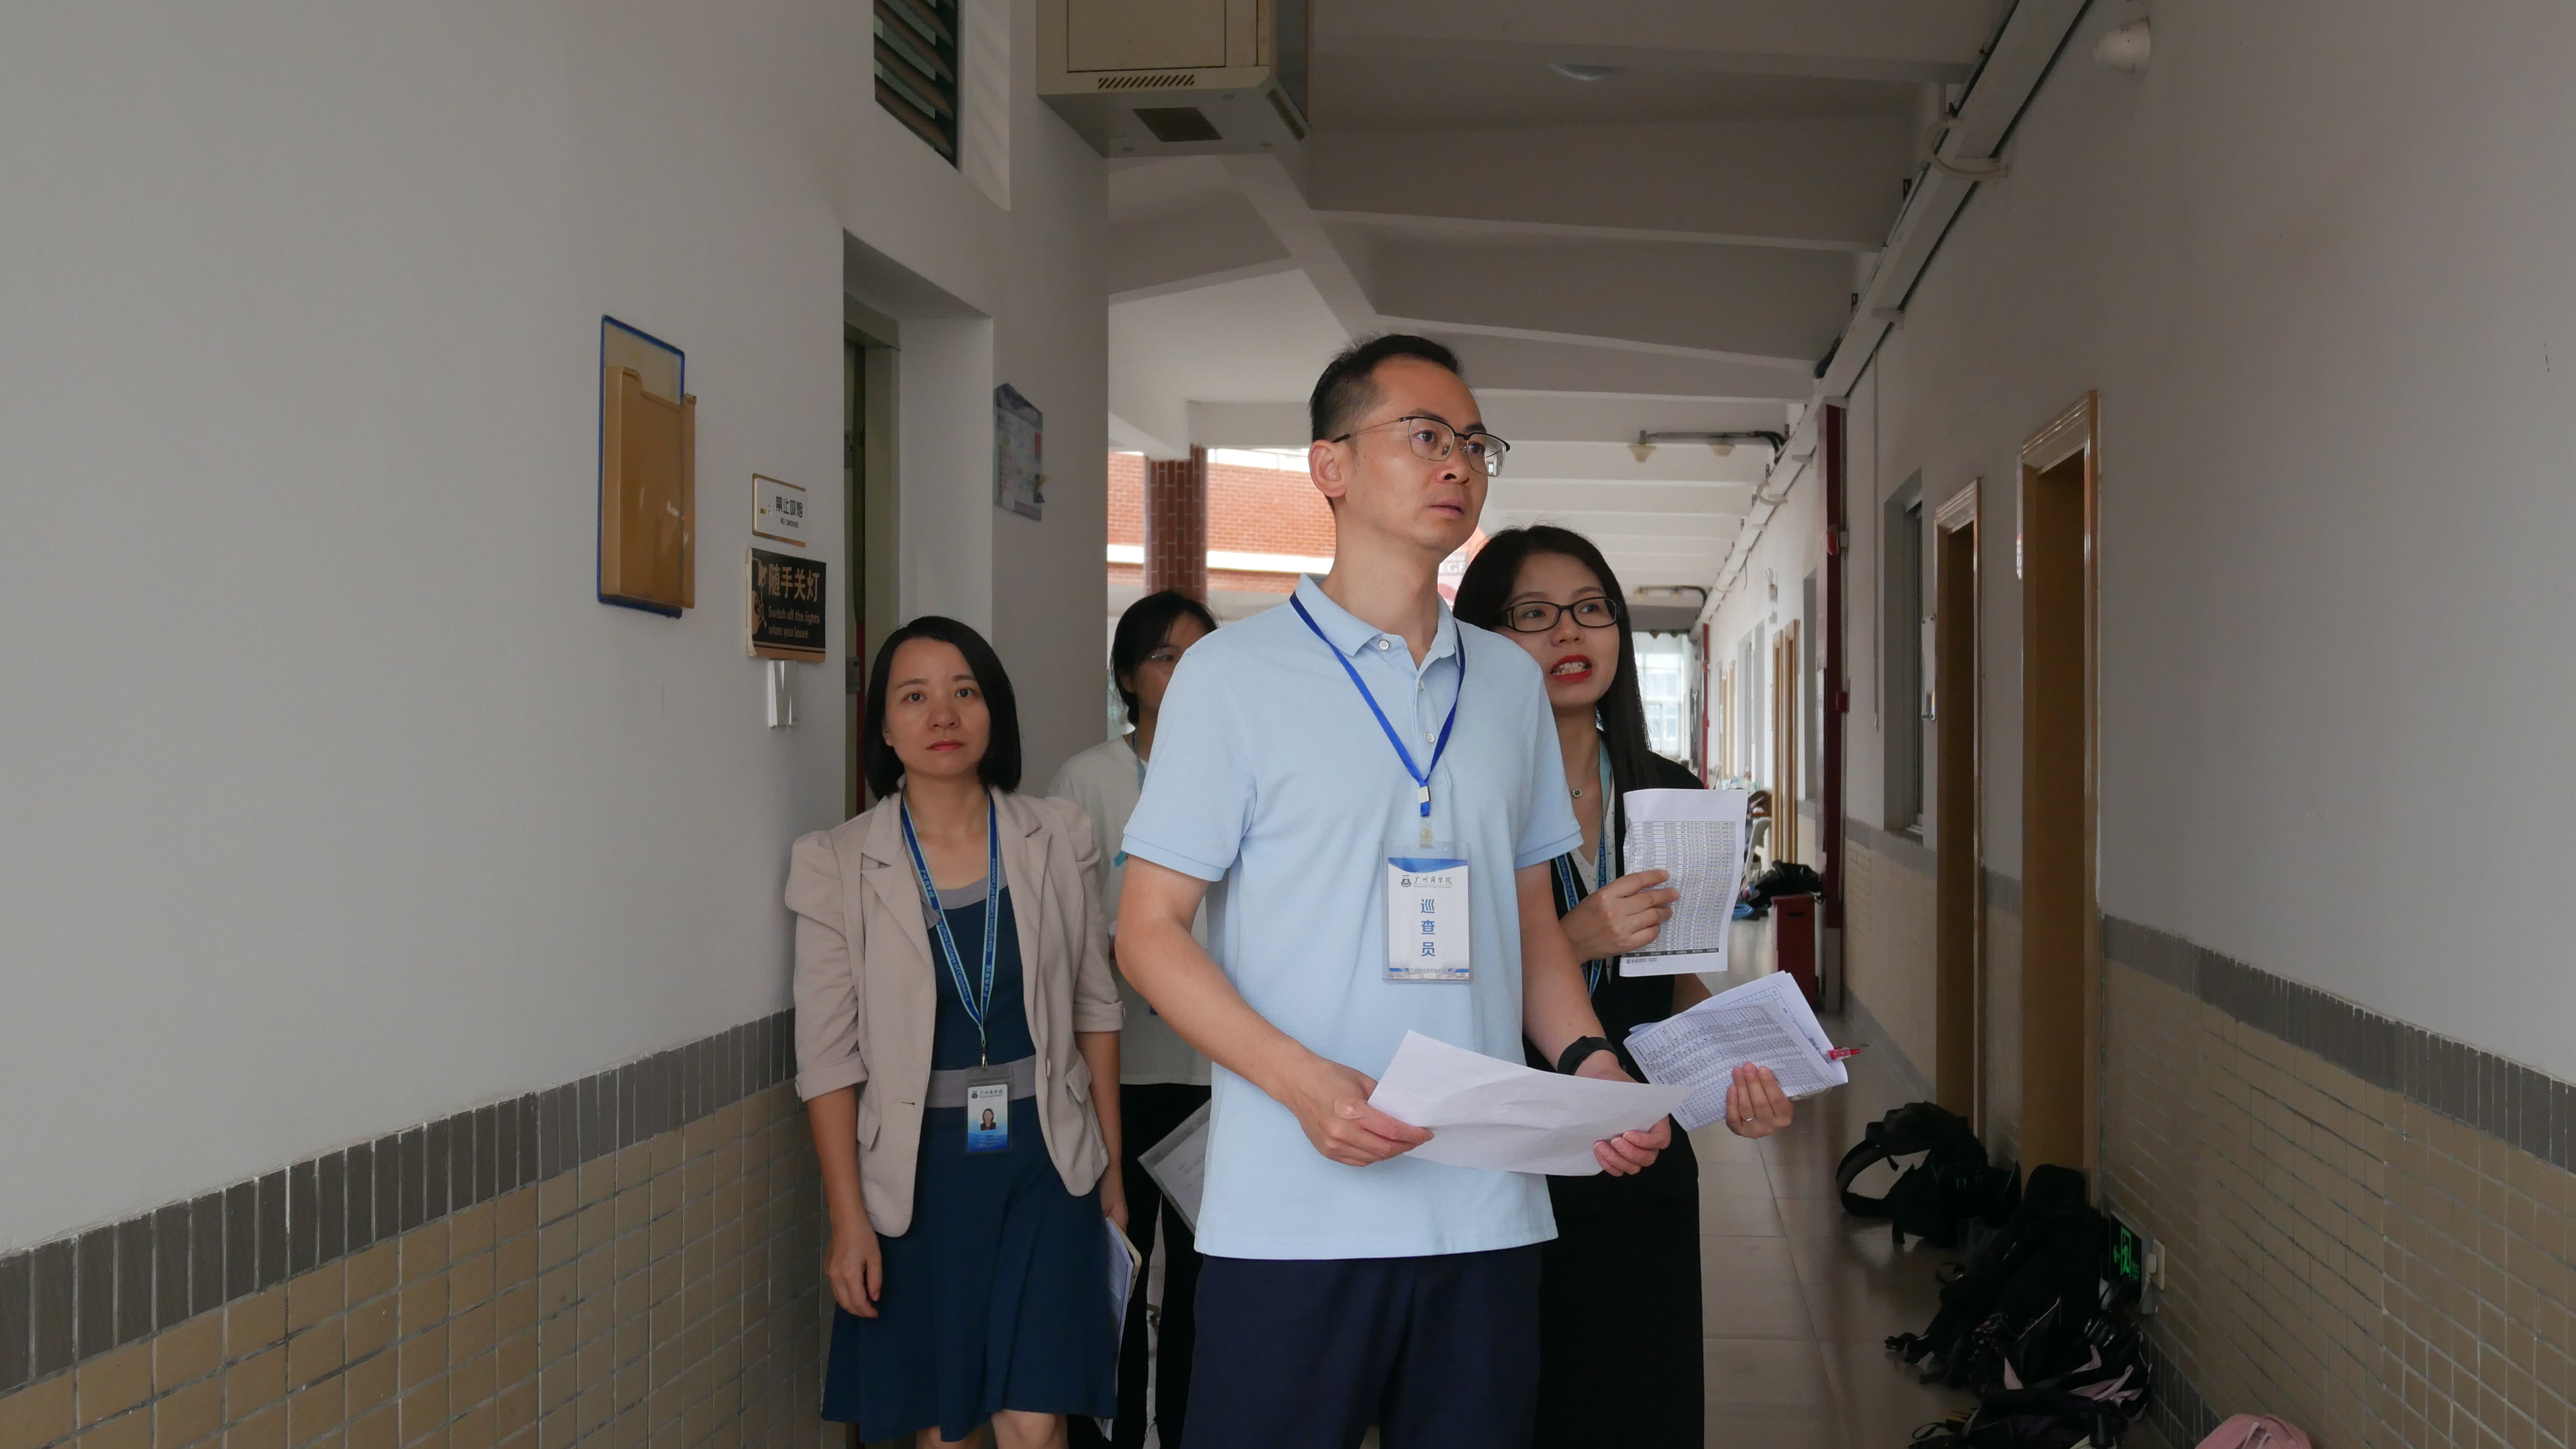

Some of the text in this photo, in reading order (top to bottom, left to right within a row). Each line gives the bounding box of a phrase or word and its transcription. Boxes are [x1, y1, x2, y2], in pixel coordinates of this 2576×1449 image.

[776, 496, 803, 518] 禁止吸烟
[768, 564, 820, 602] 随手关灯
[768, 606, 786, 619] Switch
[795, 610, 804, 622] the
[805, 611, 820, 625] lights
[768, 625, 809, 639] when you leave.
[1414, 875, 1452, 884] 广州商学院
[1560, 857, 1572, 896] Guangzhou
[986, 919, 994, 953] Guangzhou
[1421, 898, 1436, 957] 巡查员
[946, 941, 957, 963] College
